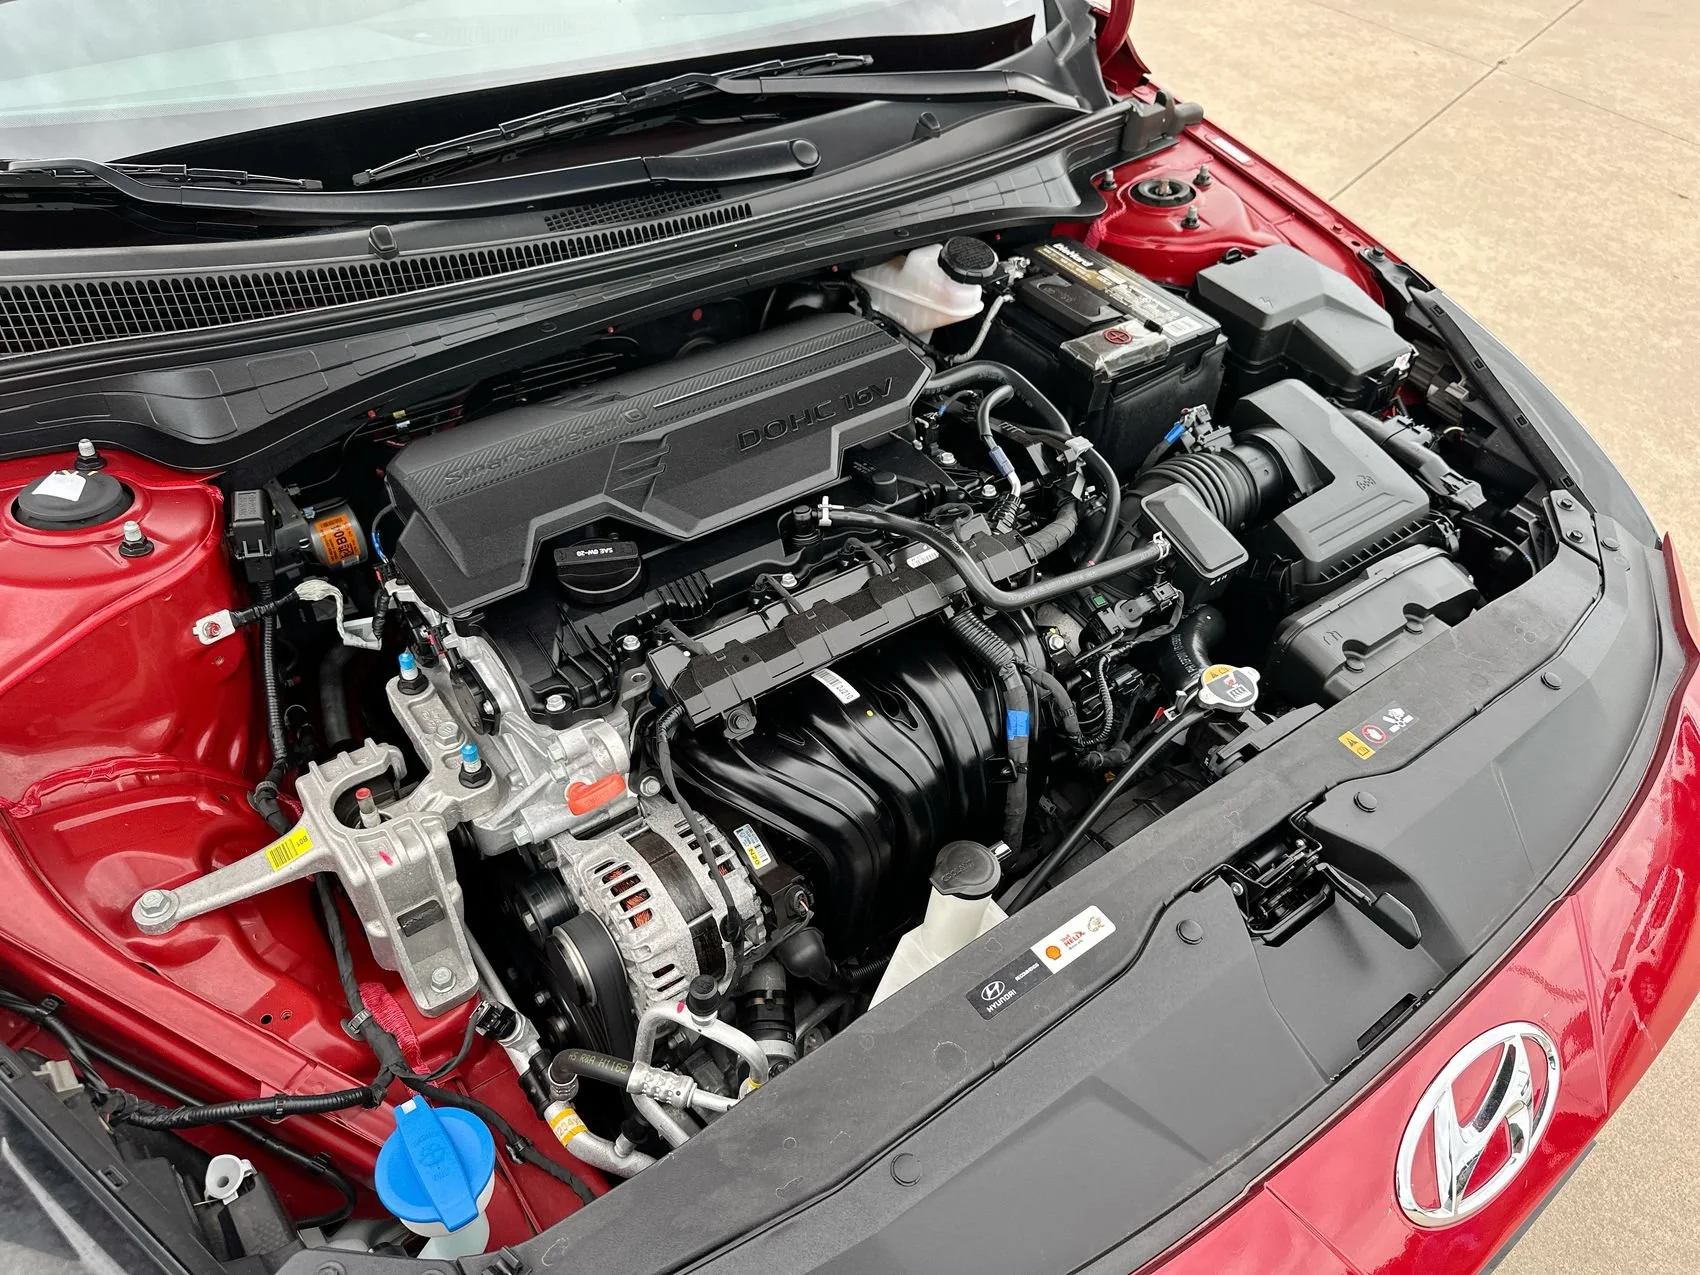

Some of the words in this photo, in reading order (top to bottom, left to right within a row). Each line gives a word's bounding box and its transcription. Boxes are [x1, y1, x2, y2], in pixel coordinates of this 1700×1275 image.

[1052, 242, 1094, 267] DieHard
[736, 399, 836, 451] DOHC
[840, 376, 893, 411] 16V
[576, 548, 599, 557] 0W-20
[599, 547, 614, 555] SAE
[1063, 930, 1086, 948] HELIX
[986, 989, 1017, 1013] HYUNDAI
